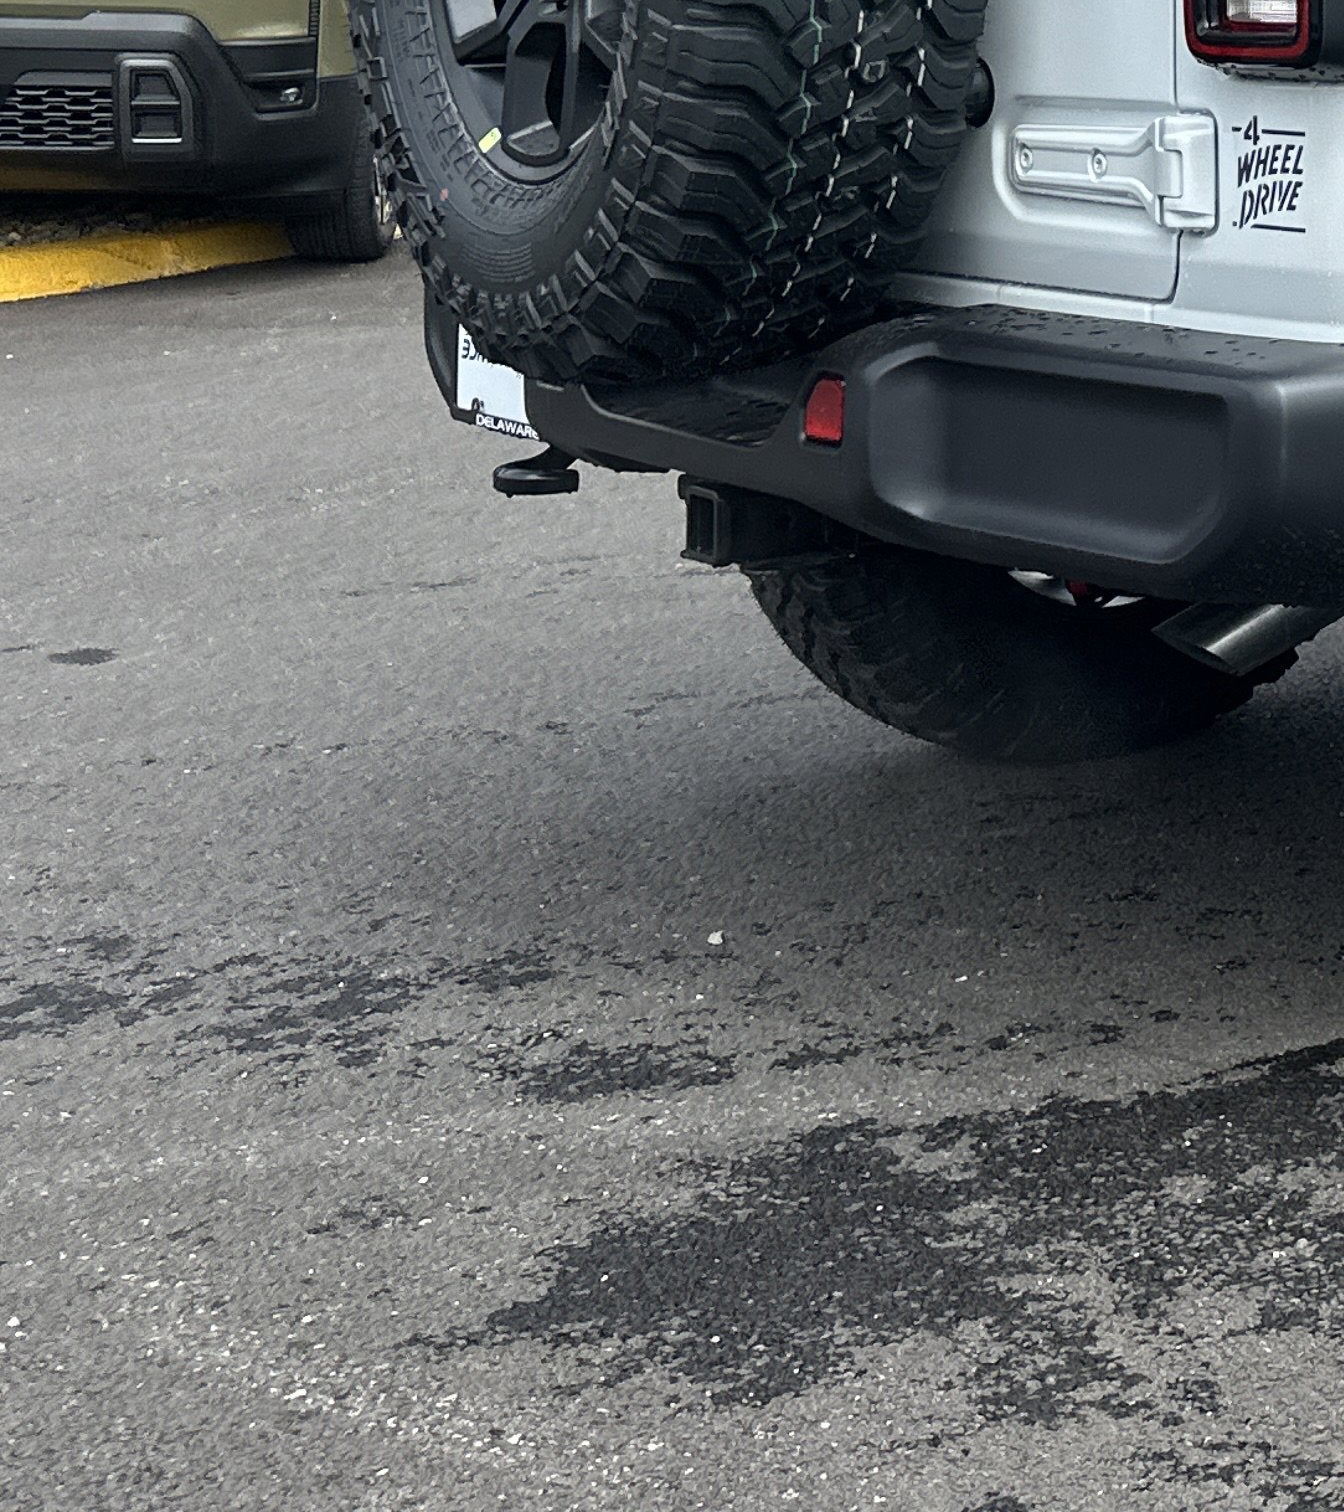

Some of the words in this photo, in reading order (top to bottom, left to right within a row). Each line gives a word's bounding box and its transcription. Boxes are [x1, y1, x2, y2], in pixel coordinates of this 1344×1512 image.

[1243, 115, 1260, 145] 4
[1238, 144, 1304, 187] WHEEL
[1239, 180, 1304, 229] DRIVE
[475, 413, 540, 440] DELAWARE
